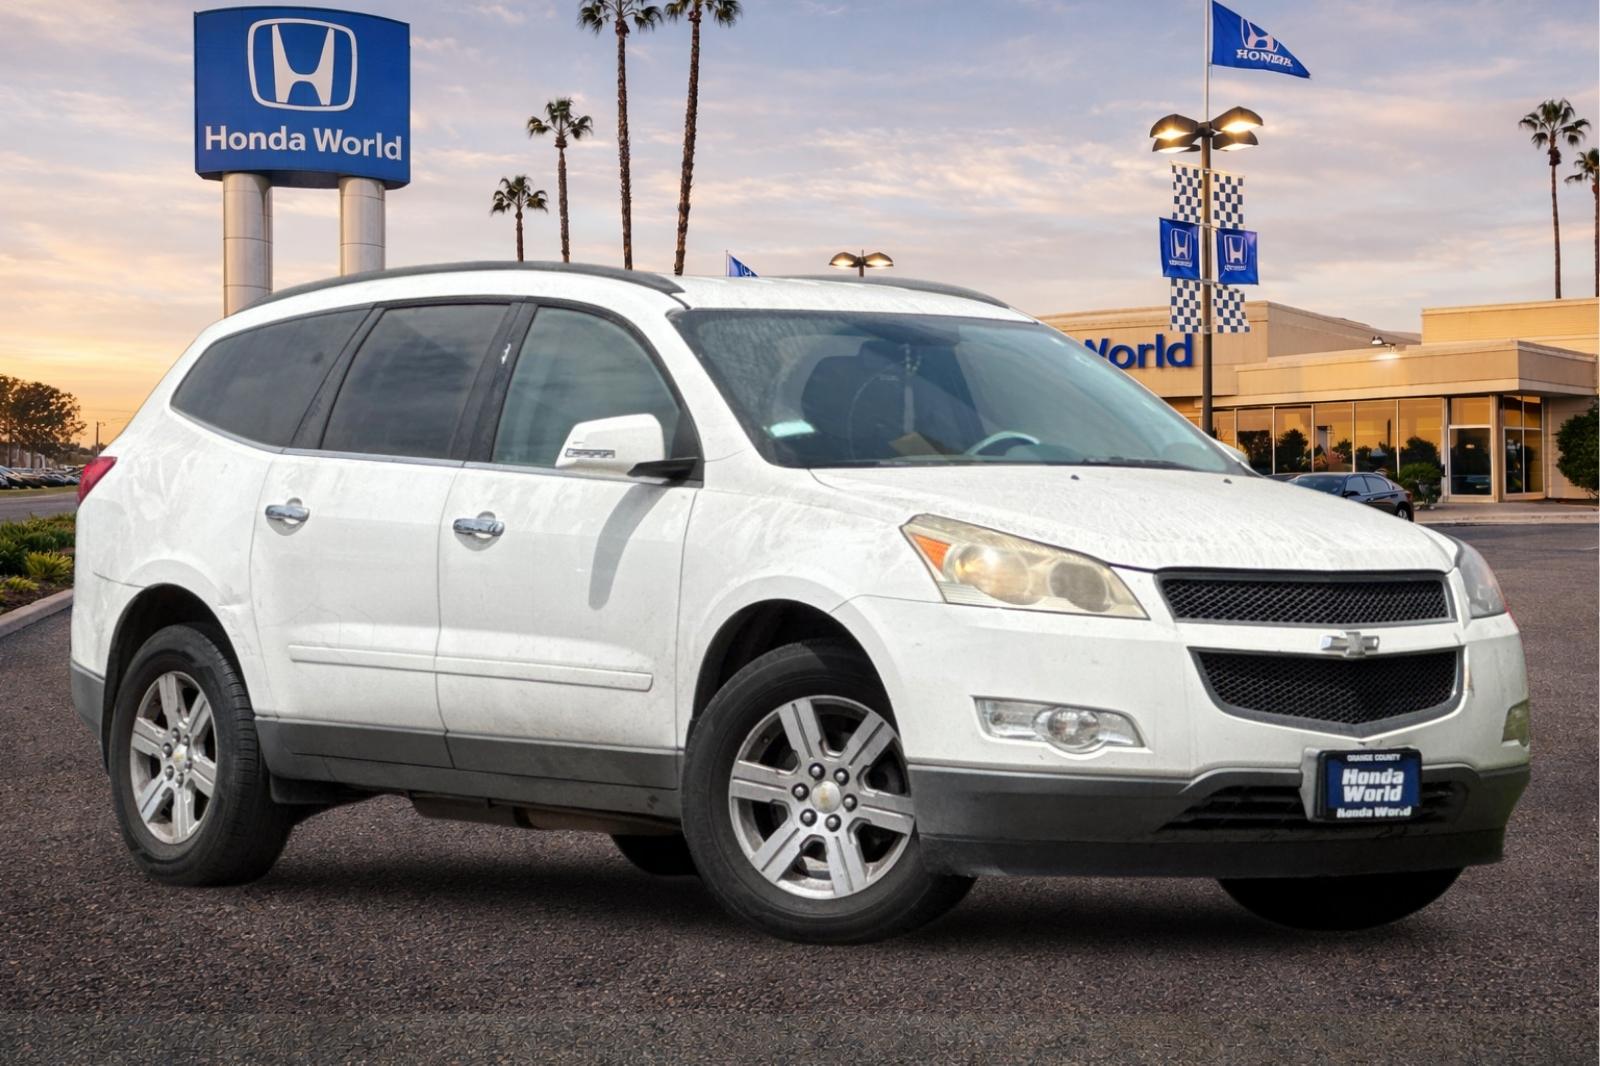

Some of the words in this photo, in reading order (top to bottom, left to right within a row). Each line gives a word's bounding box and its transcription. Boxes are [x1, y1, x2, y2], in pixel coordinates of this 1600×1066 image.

[205, 125, 306, 151] Honda
[312, 127, 402, 161] World
[1342, 768, 1404, 785] Honda
[1344, 785, 1403, 802] World
